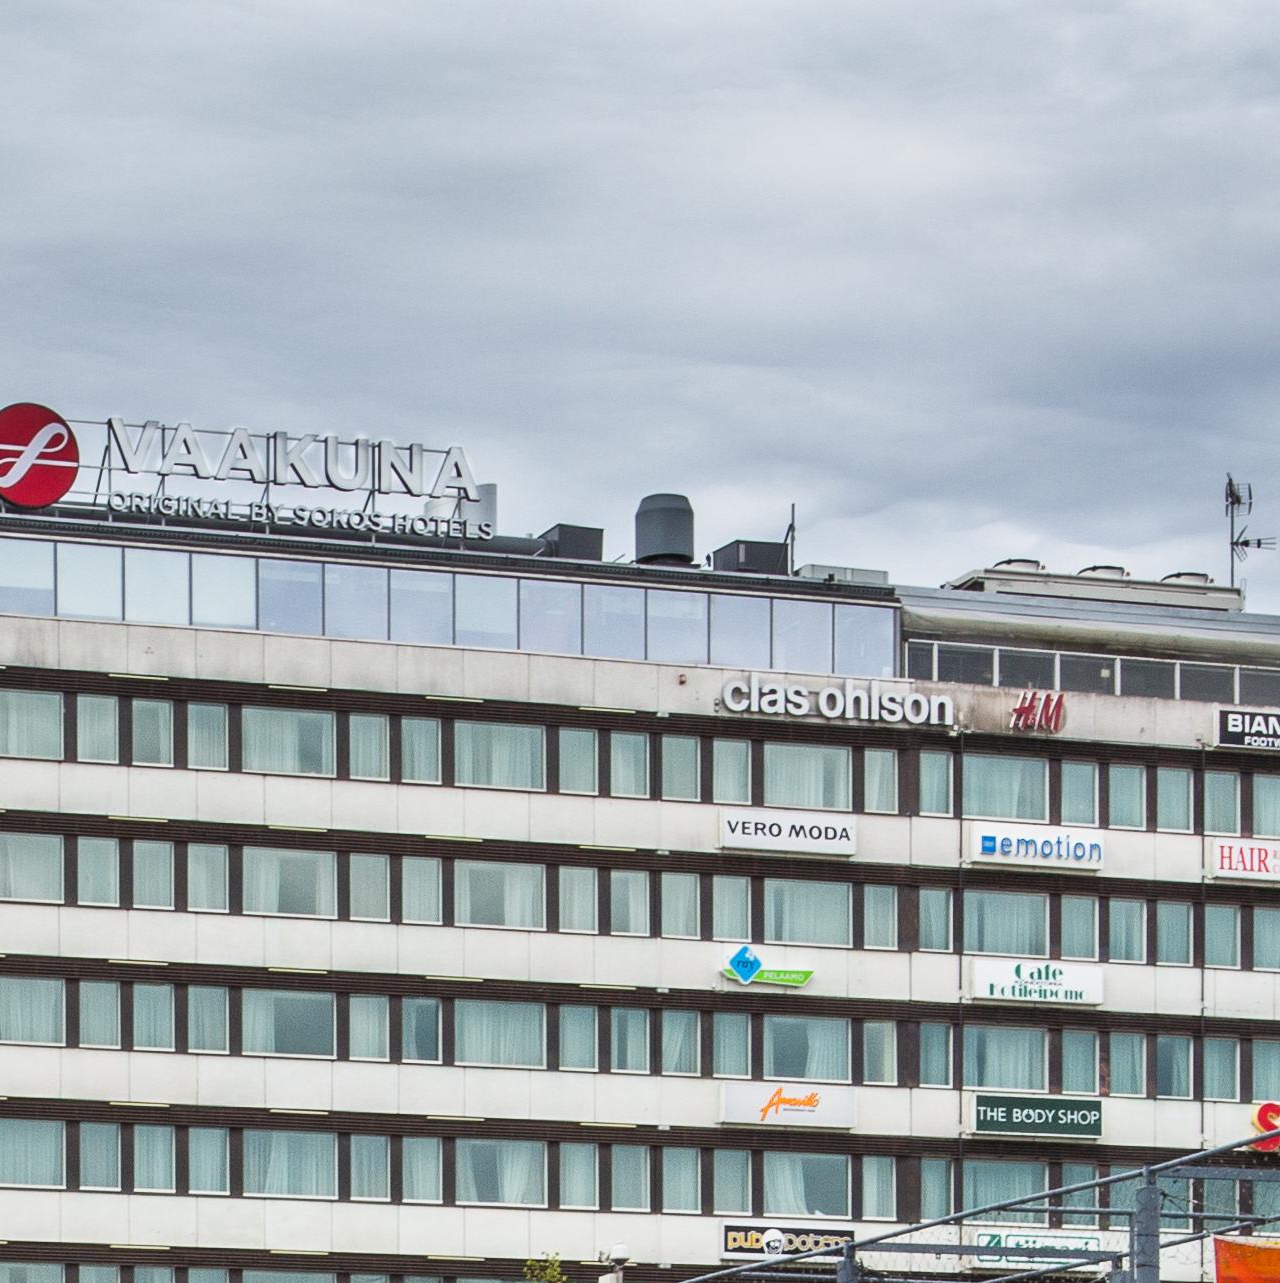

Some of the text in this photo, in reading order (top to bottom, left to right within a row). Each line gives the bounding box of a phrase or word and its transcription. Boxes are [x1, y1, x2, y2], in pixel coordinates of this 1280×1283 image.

[108, 417, 481, 501] VAAKUNA
[109, 491, 494, 541] ORIGINAL BY SOKOS HOTELS
[723, 672, 954, 726] clas ohlson
[1009, 691, 1064, 732] H&M
[727, 820, 851, 842] VERO MODA
[1000, 834, 1102, 862] emotion
[1218, 845, 1270, 873] HAIR
[977, 1106, 1100, 1125] THE BODY SHOP
